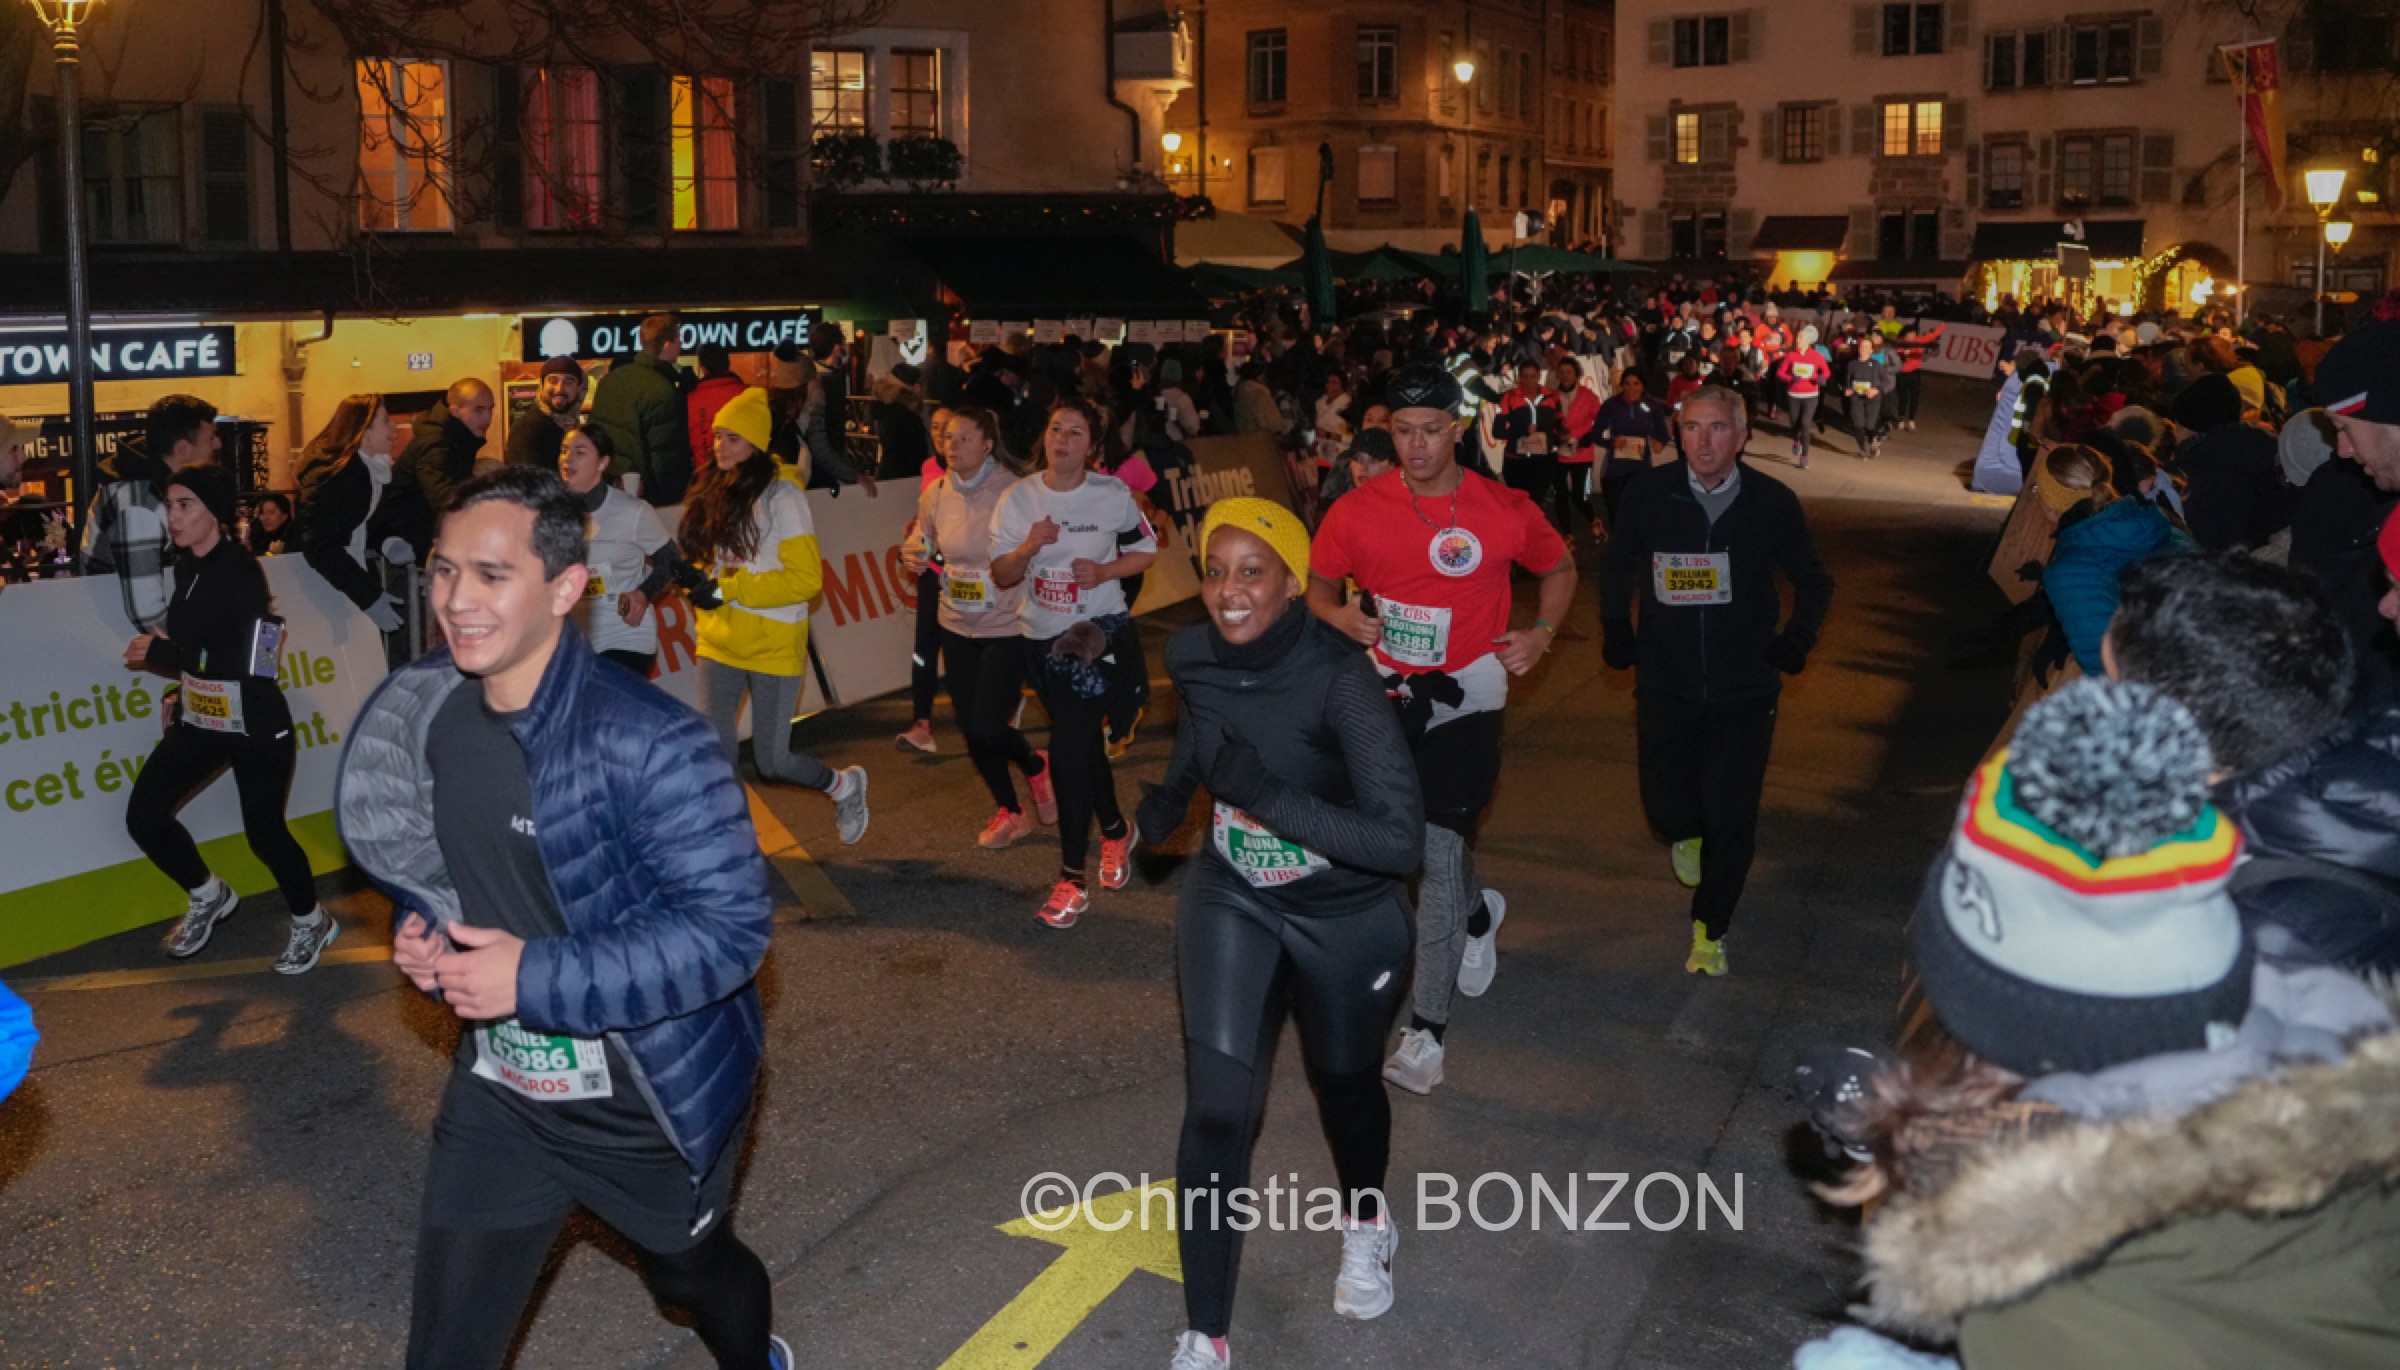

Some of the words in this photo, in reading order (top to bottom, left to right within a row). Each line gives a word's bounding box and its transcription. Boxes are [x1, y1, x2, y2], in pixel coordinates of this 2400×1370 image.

[680, 322, 738, 348] OWN
[746, 313, 810, 343] CAFÉ
[119, 333, 221, 371] CAFÉ
[1946, 333, 1996, 366] UBS
[1164, 464, 1255, 511] Tribune
[1683, 555, 1711, 567] UBS
[1669, 579, 1713, 591] 32942
[1403, 607, 1431, 623] UBS
[5, 761, 84, 812] cet
[1233, 847, 1300, 868] 30733
[1263, 868, 1302, 883] UBS
[501, 1066, 571, 1094] MIGROS
